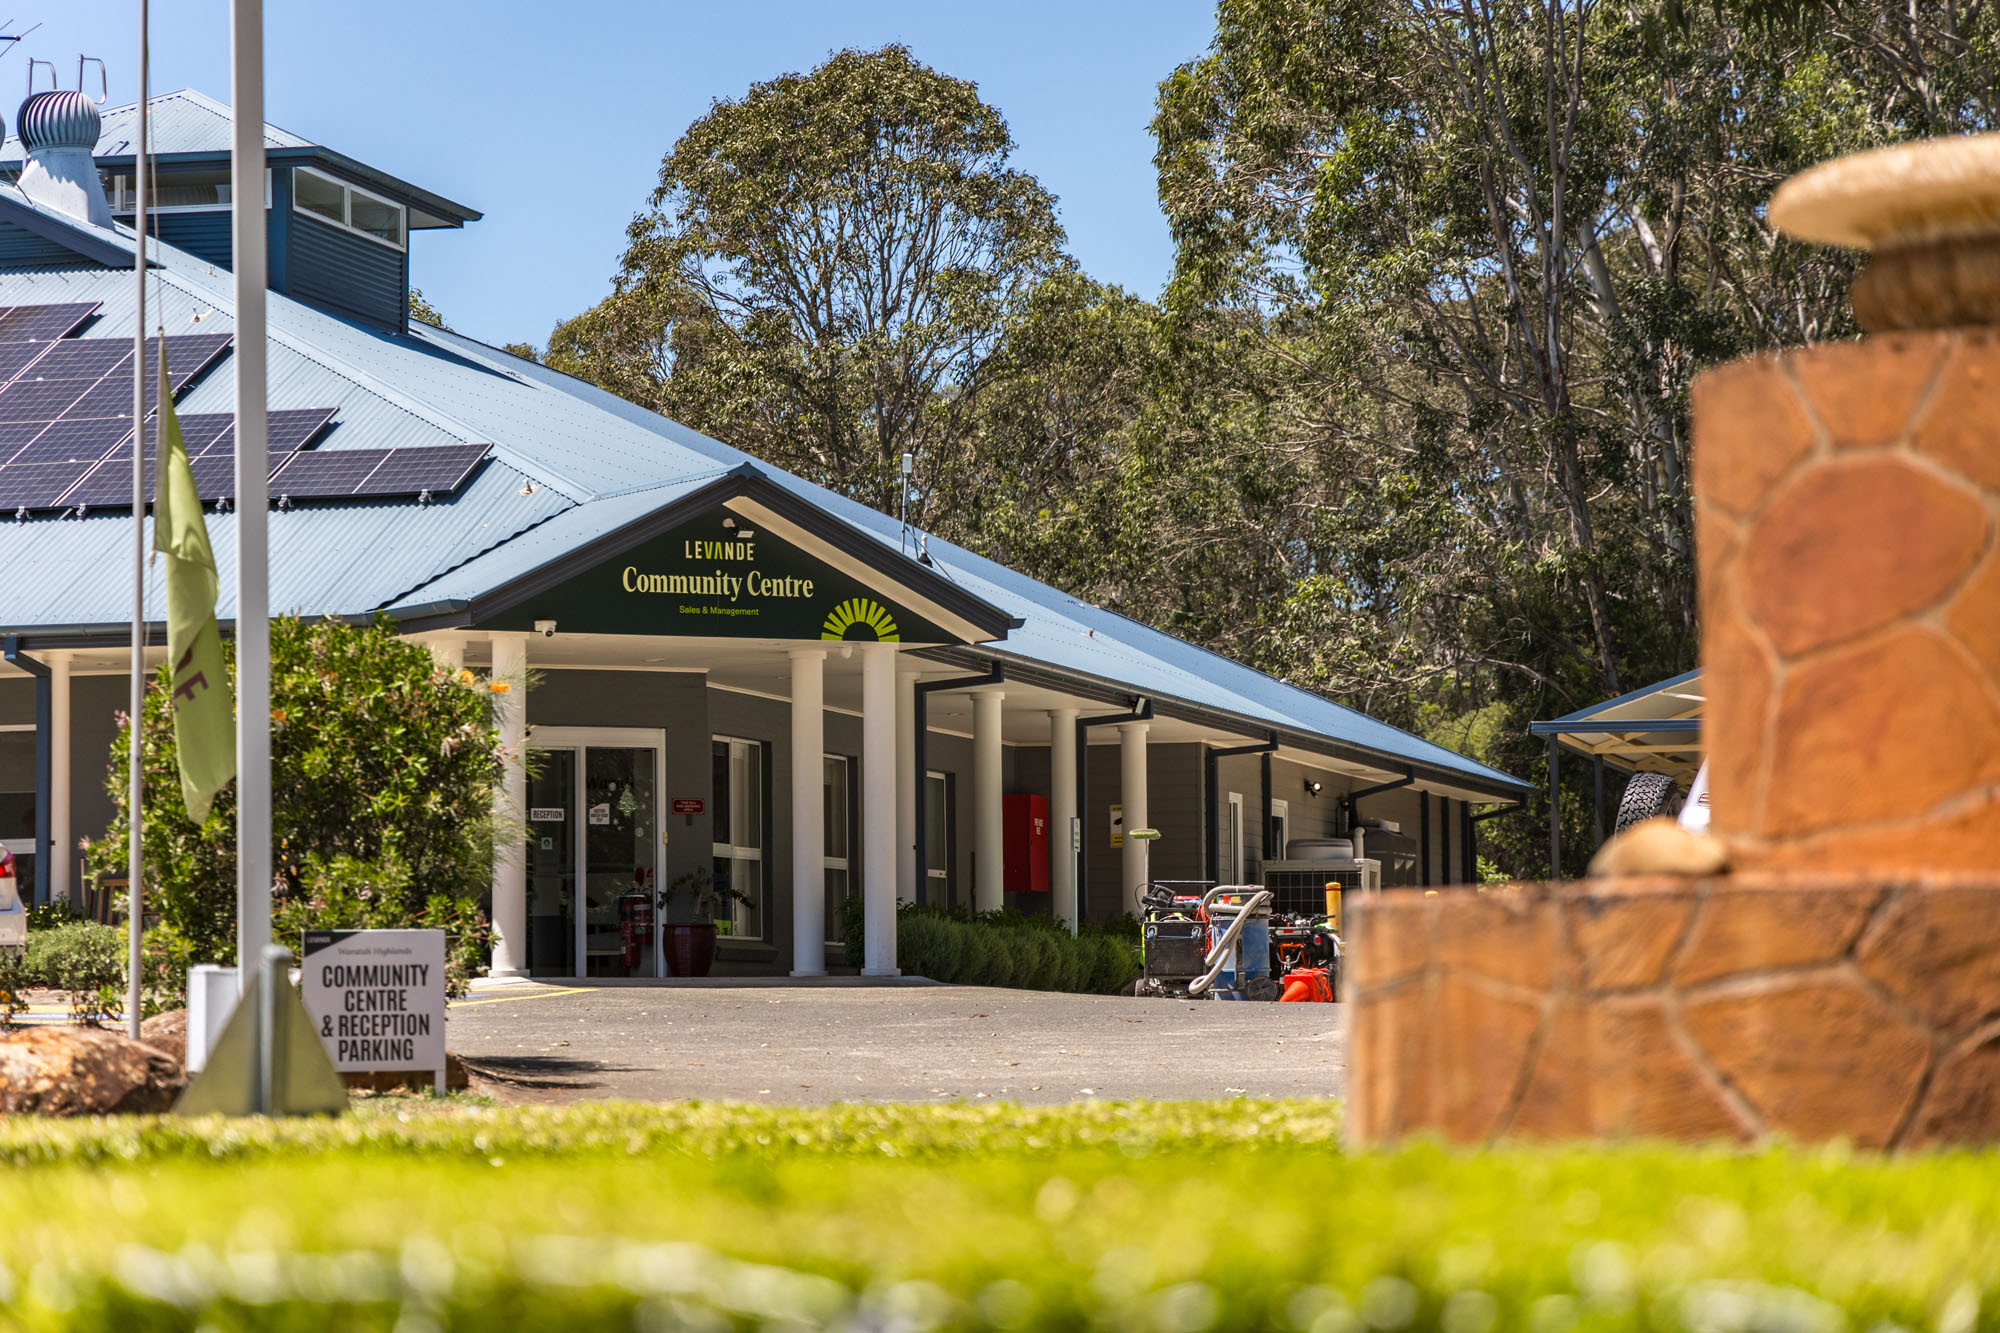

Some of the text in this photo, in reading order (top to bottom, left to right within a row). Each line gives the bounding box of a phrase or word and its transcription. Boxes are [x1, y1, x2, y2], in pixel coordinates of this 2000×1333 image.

[685, 540, 755, 561] LEVANDE
[622, 566, 814, 602] Community Centre
[679, 605, 759, 617] Sales & Management
[533, 810, 563, 819] RECEPTION
[322, 964, 429, 988] COMMUNITY
[344, 989, 407, 1012] CENTRE
[321, 1014, 430, 1038] & RECEPTION
[338, 1038, 414, 1062] PARKING
